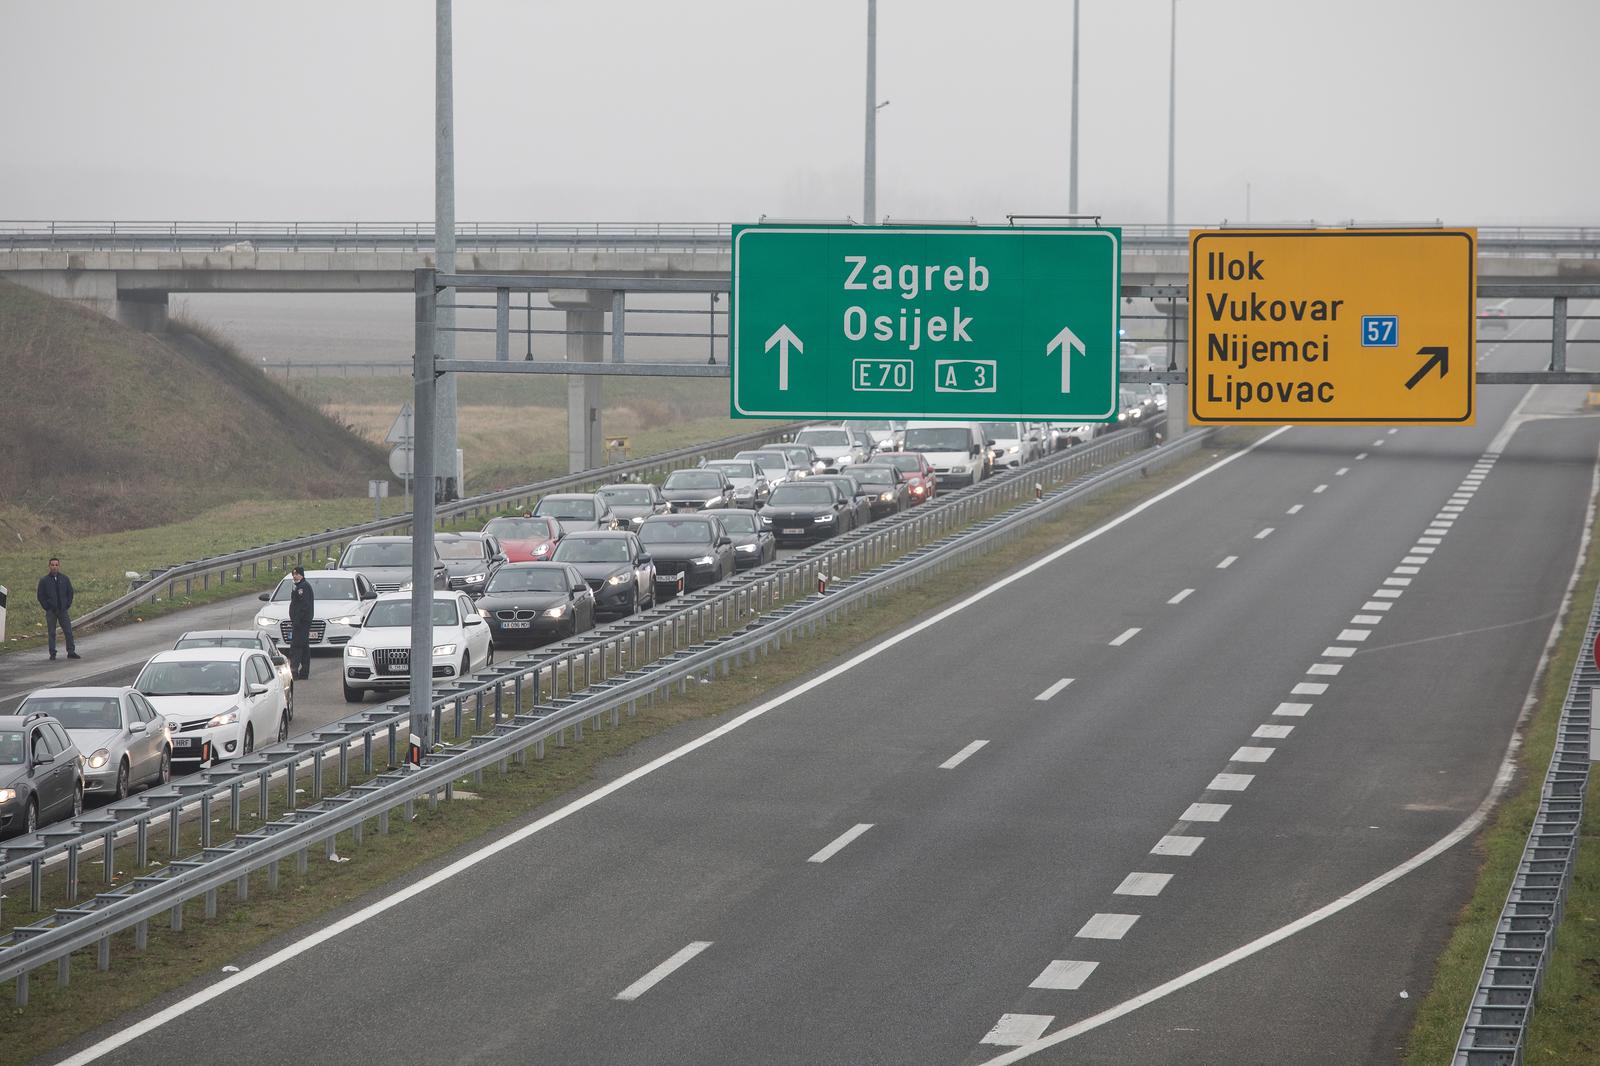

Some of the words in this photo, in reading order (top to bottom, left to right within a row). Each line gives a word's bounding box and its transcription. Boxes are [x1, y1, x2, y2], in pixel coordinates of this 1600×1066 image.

[844, 256, 989, 299] Zagreb
[1209, 251, 1264, 281] Ilok
[1206, 292, 1344, 321] Vukovar
[844, 306, 973, 350] Osijek
[1368, 322, 1393, 341] 57
[1208, 333, 1328, 369] Nijemci
[860, 364, 870, 386] E
[879, 364, 906, 386] 70
[945, 366, 957, 386] A
[975, 366, 986, 386] 3
[1208, 374, 1334, 410] Lipovac
